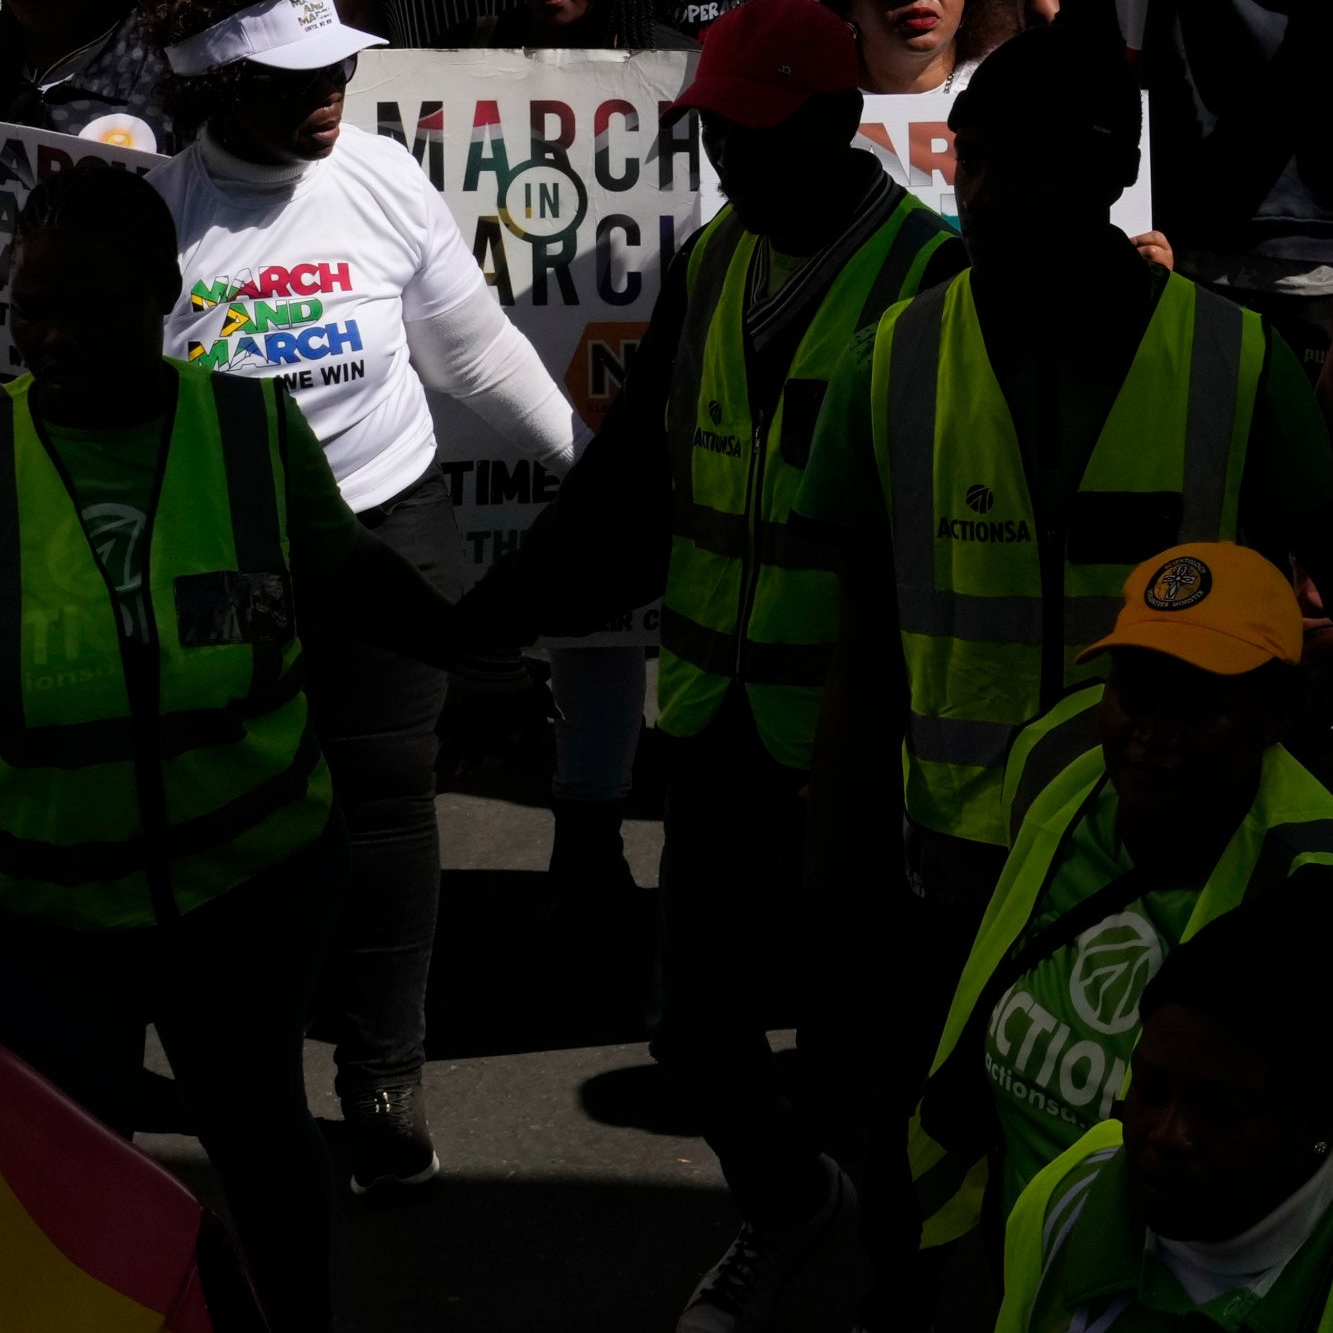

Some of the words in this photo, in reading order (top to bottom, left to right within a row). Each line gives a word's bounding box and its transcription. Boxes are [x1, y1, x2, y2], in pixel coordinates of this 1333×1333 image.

[376, 99, 703, 194] MARCH
[524, 180, 560, 220] IN
[189, 261, 353, 312] MARCH
[220, 298, 325, 337] AND
[186, 320, 363, 373] MARCH
[321, 359, 366, 386] WIN
[936, 516, 1031, 544] ACTIONSA
